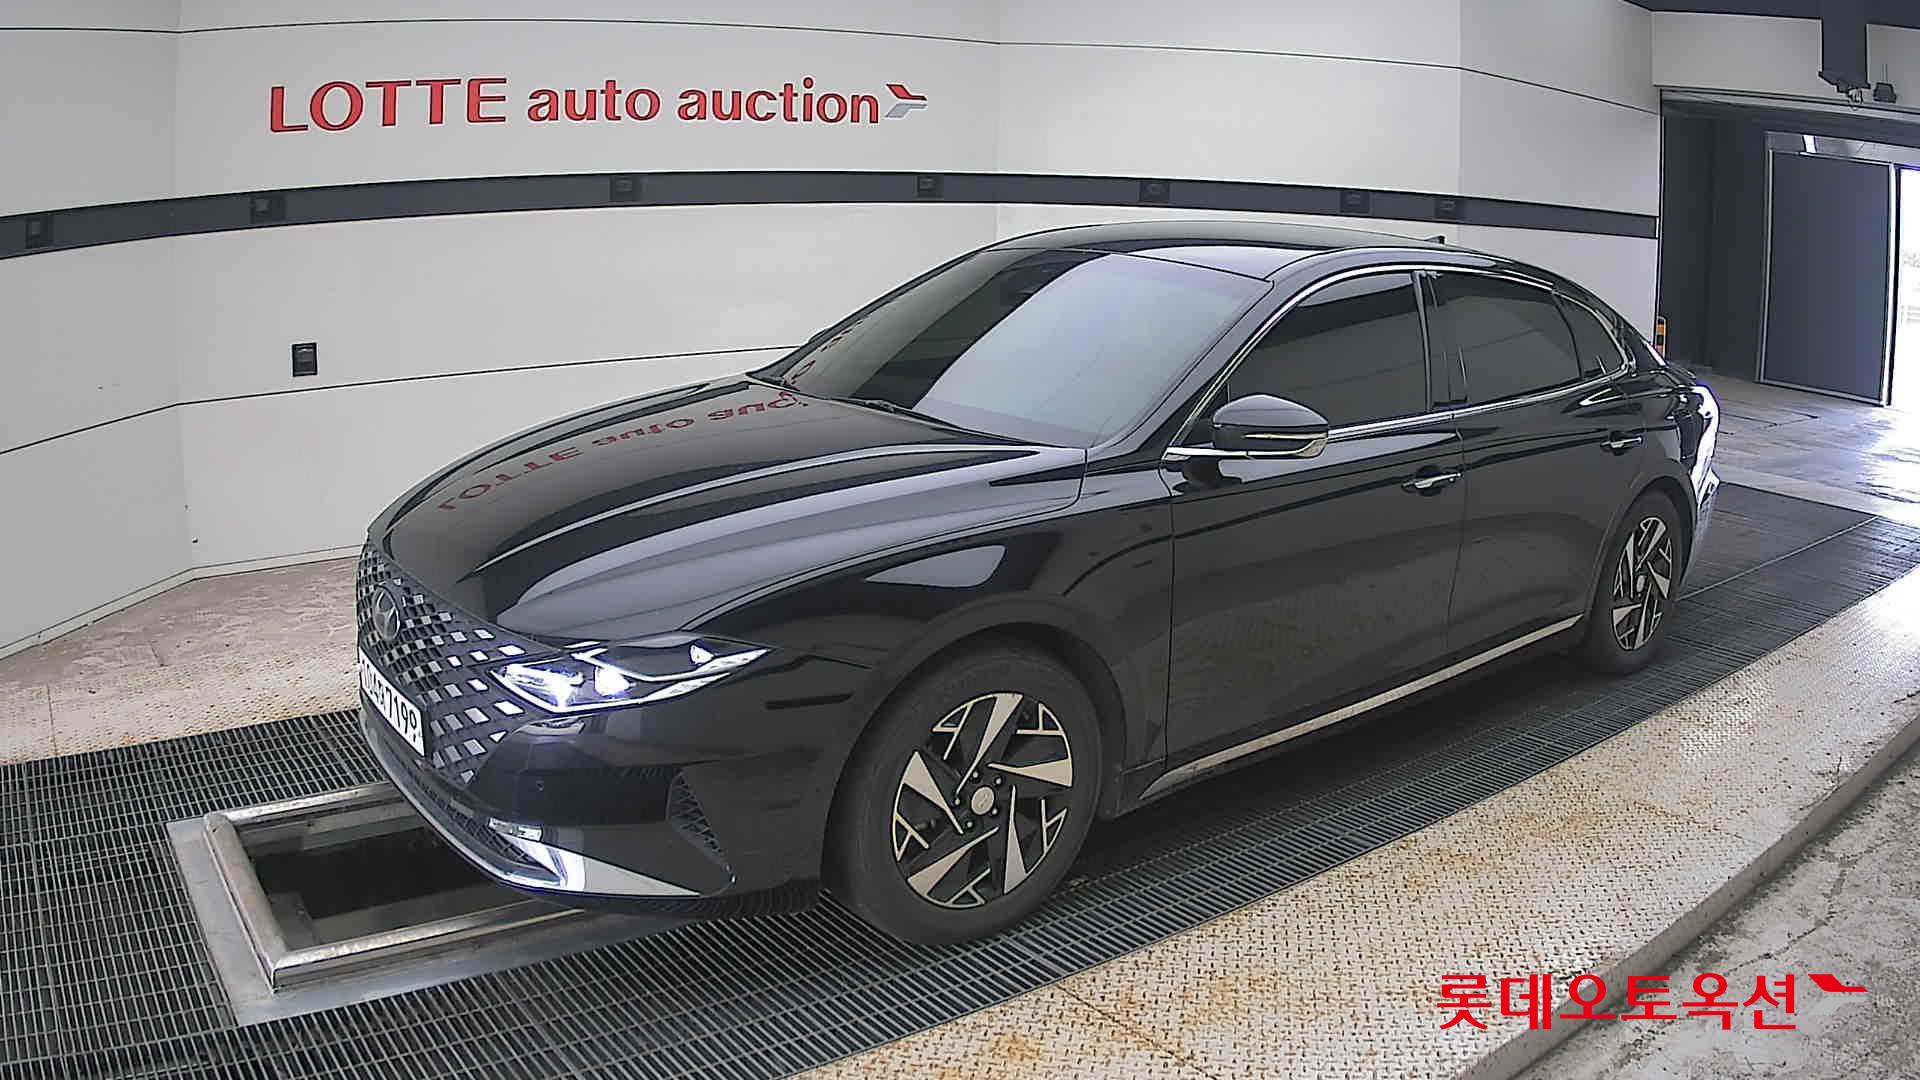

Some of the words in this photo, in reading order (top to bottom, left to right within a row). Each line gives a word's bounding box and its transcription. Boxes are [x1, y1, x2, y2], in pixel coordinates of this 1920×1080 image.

[270, 77, 507, 133] LOTTE
[527, 79, 662, 123] auto
[676, 78, 880, 124] auction
